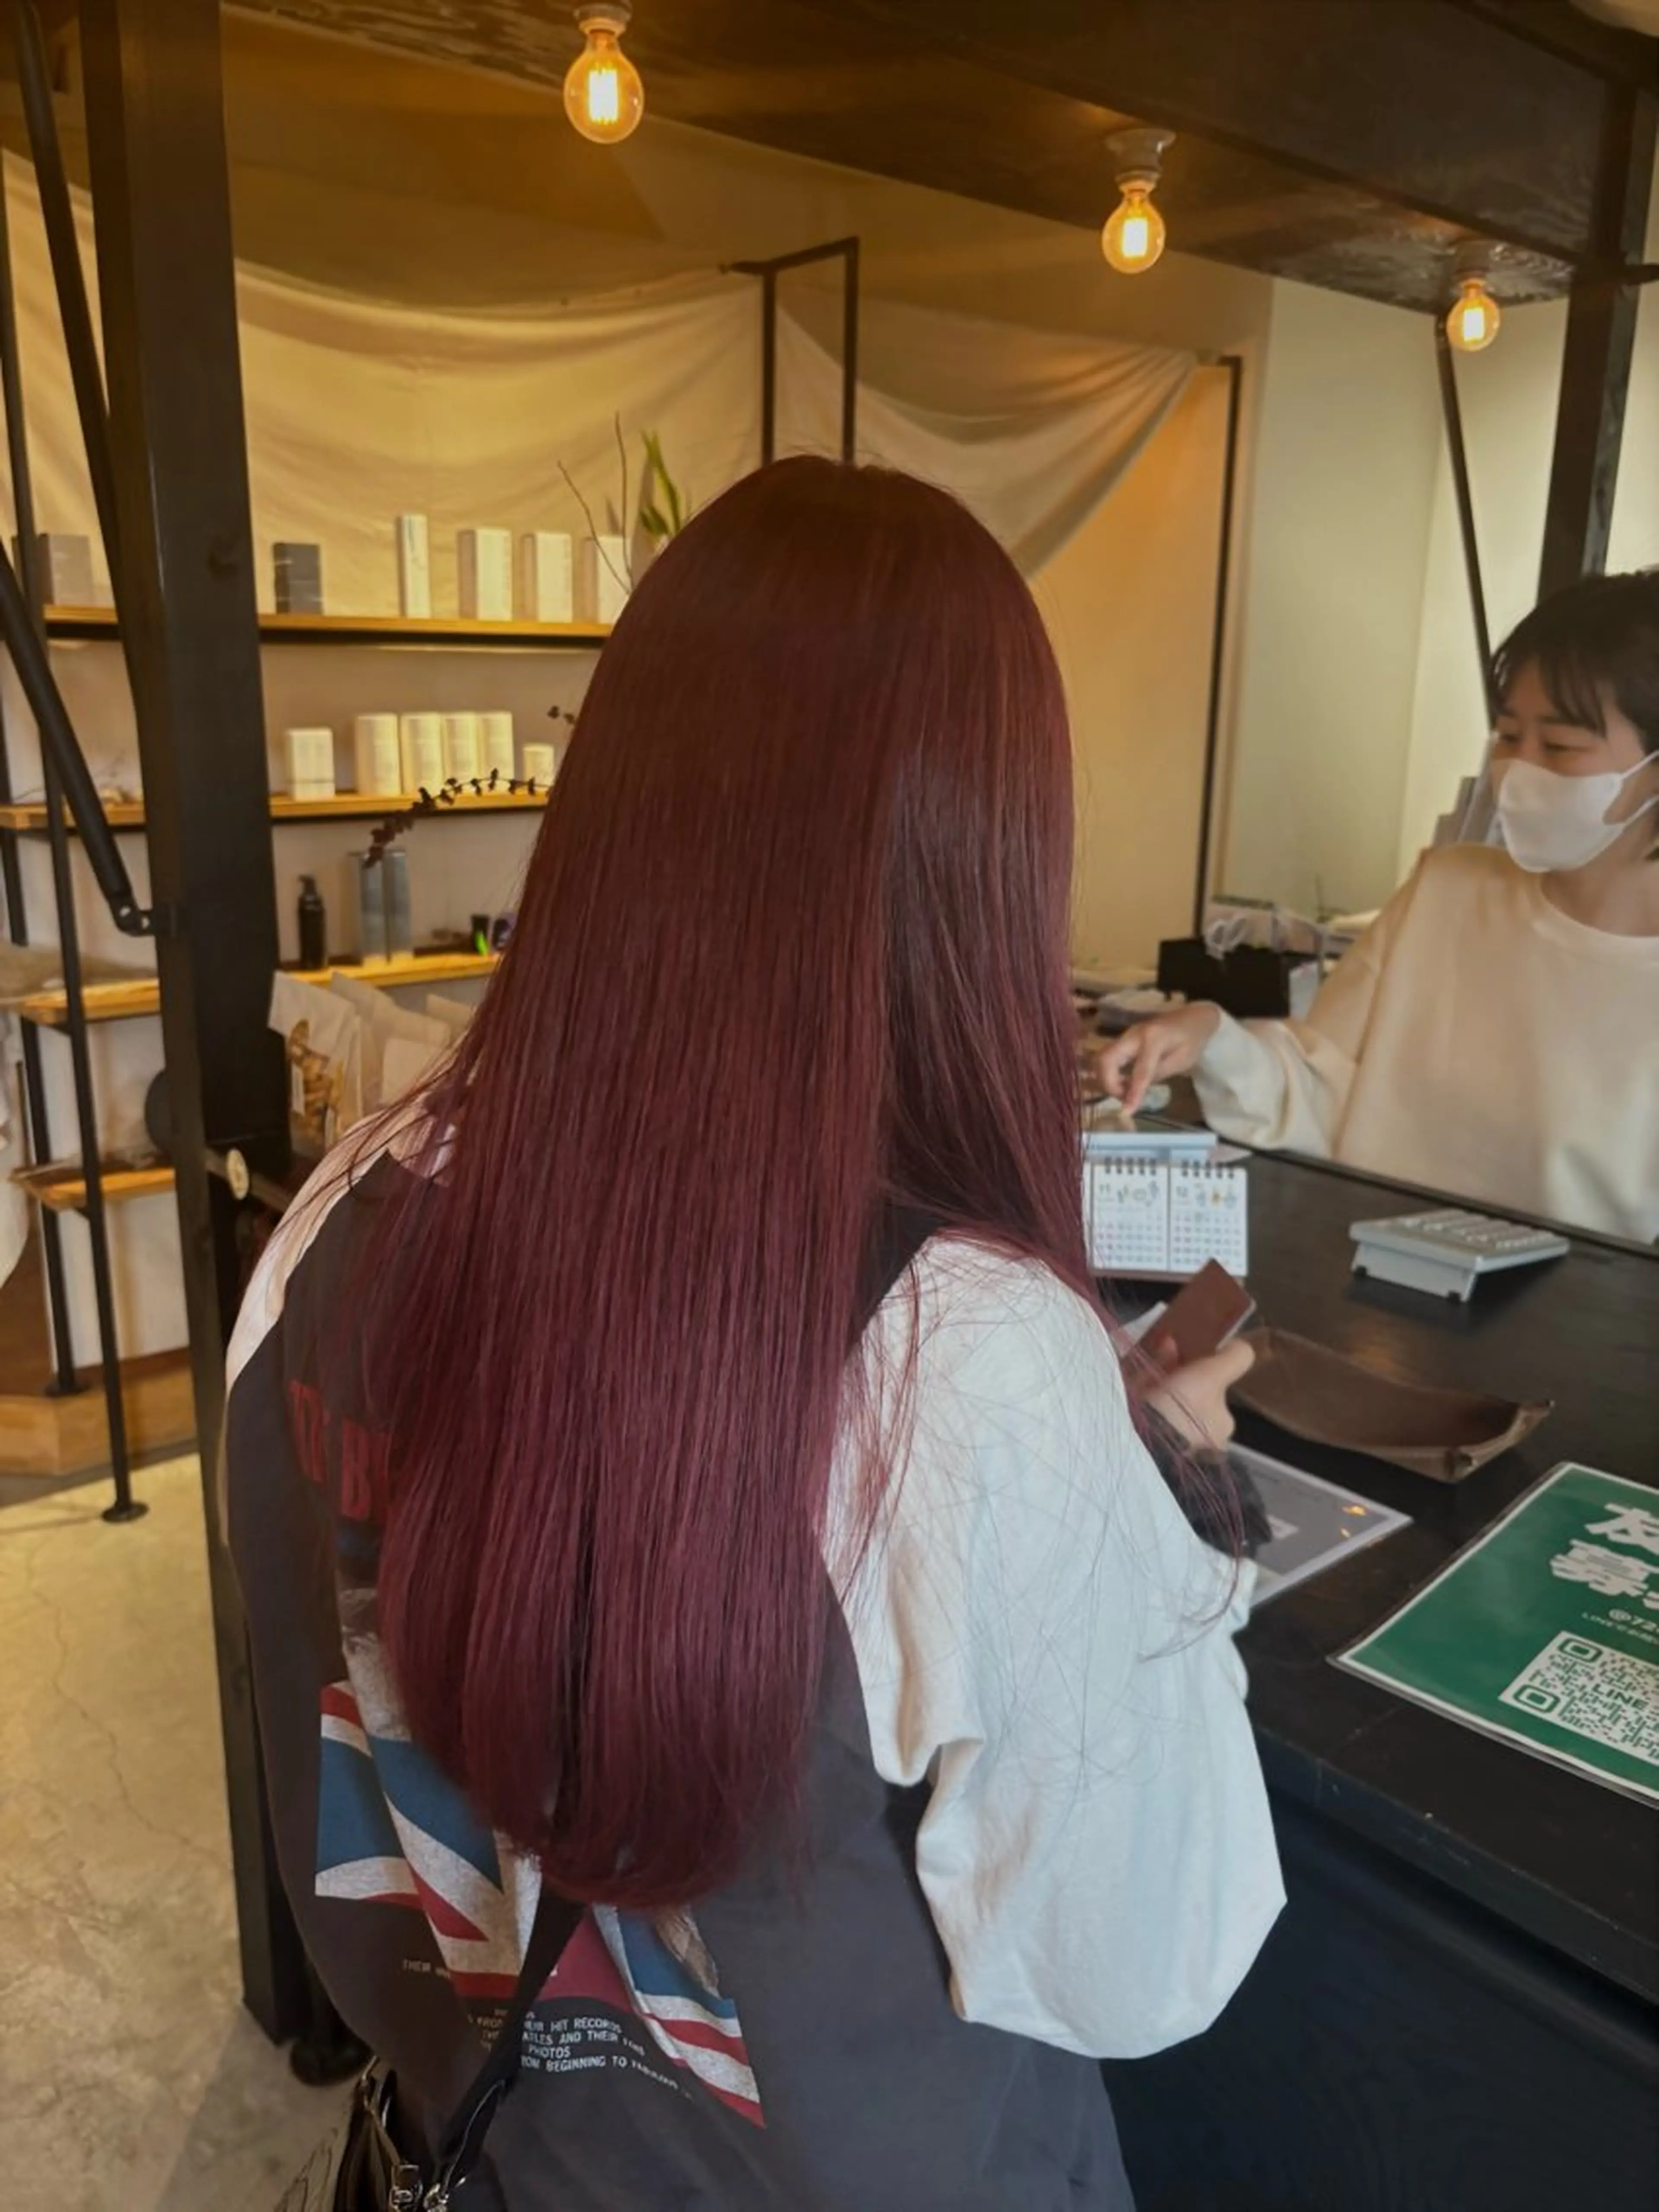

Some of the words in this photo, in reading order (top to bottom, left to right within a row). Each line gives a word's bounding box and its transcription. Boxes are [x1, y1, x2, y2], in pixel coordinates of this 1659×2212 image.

[1549, 1538, 1659, 1610] 募
[1592, 1683, 1649, 1710] LINE
[550, 2019, 569, 2032] HIT
[574, 2017, 623, 2034] RECORDS
[559, 2031, 582, 2045] AND
[587, 2030, 618, 2042] THEIR
[529, 2044, 571, 2059] PHOTOS
[546, 2056, 607, 2073] BEGINNING
[612, 2056, 628, 2068] TO
